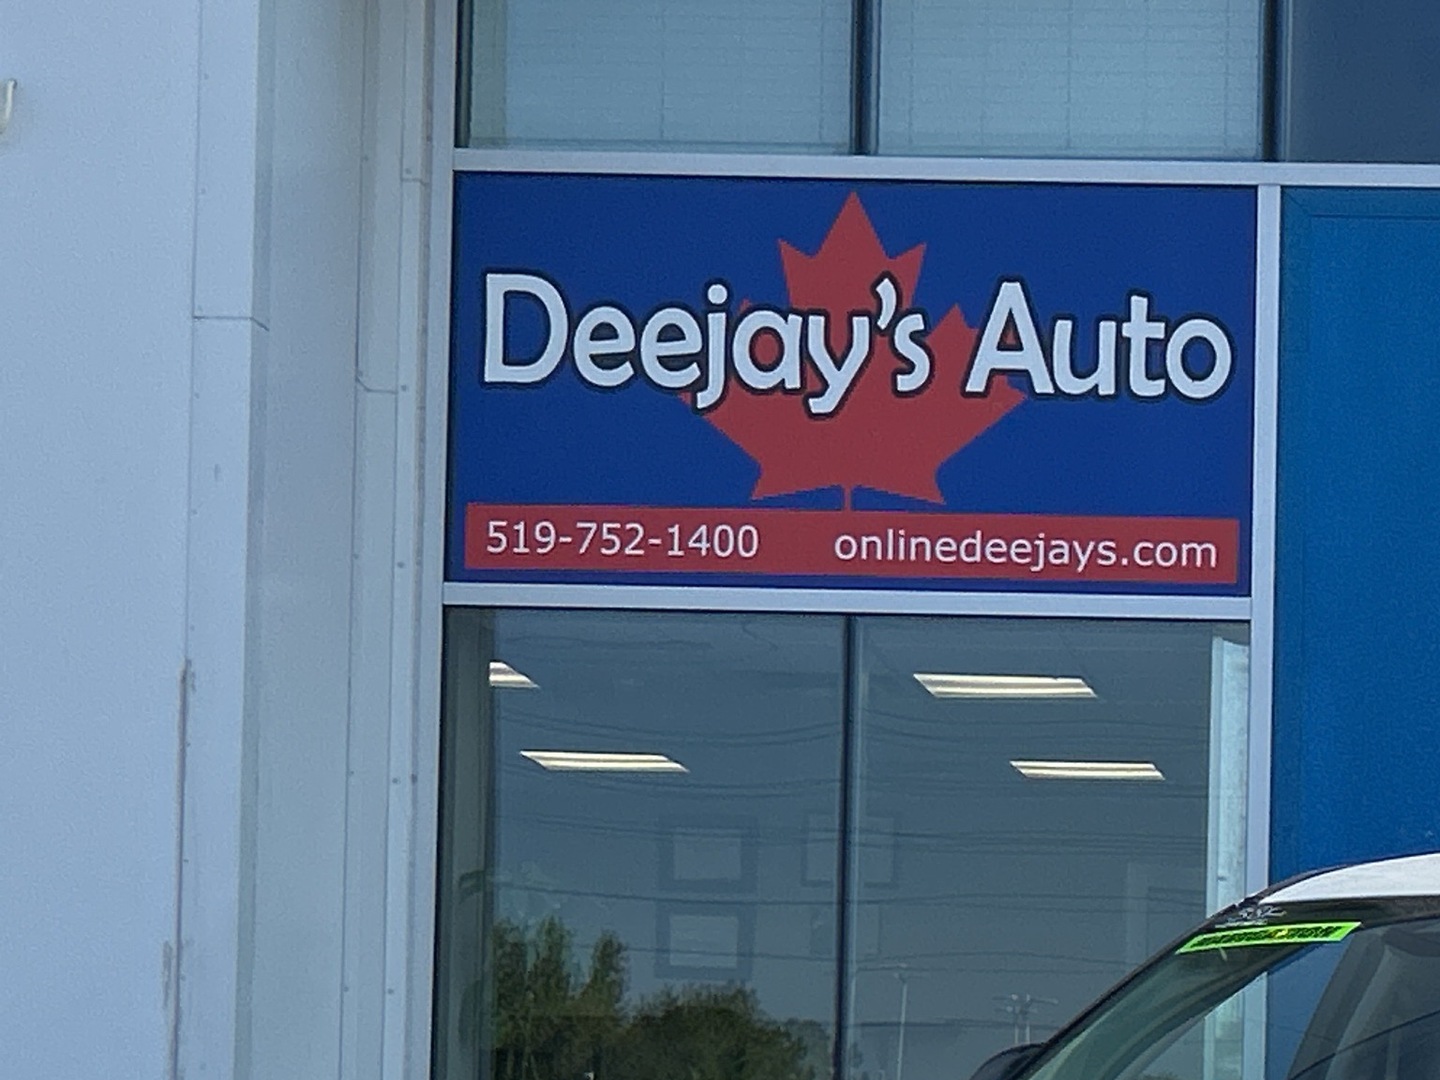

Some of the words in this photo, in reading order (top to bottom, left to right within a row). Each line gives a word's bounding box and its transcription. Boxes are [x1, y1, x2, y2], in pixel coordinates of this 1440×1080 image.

[481, 271, 932, 415] Deejay's
[965, 281, 1232, 399] Auto
[485, 520, 760, 558] 519-752-1400
[834, 529, 1218, 572] onlinedeejays.com
